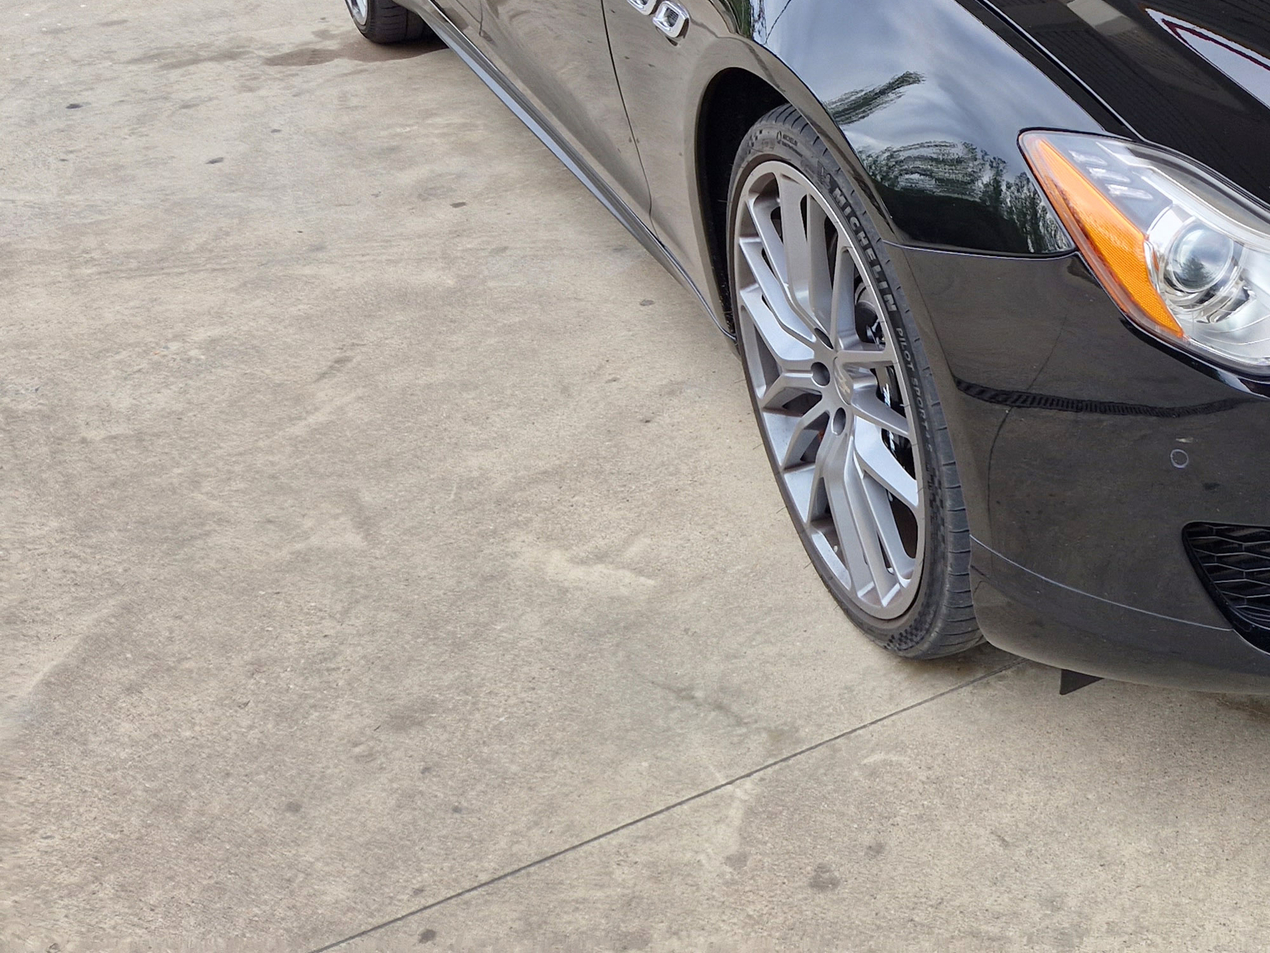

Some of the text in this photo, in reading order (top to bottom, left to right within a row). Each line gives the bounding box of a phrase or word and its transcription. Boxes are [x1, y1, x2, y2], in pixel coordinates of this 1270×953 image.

[832, 187, 897, 312] MICHELIN
[895, 327, 915, 372] PILOT
[911, 378, 929, 431] SPORT
